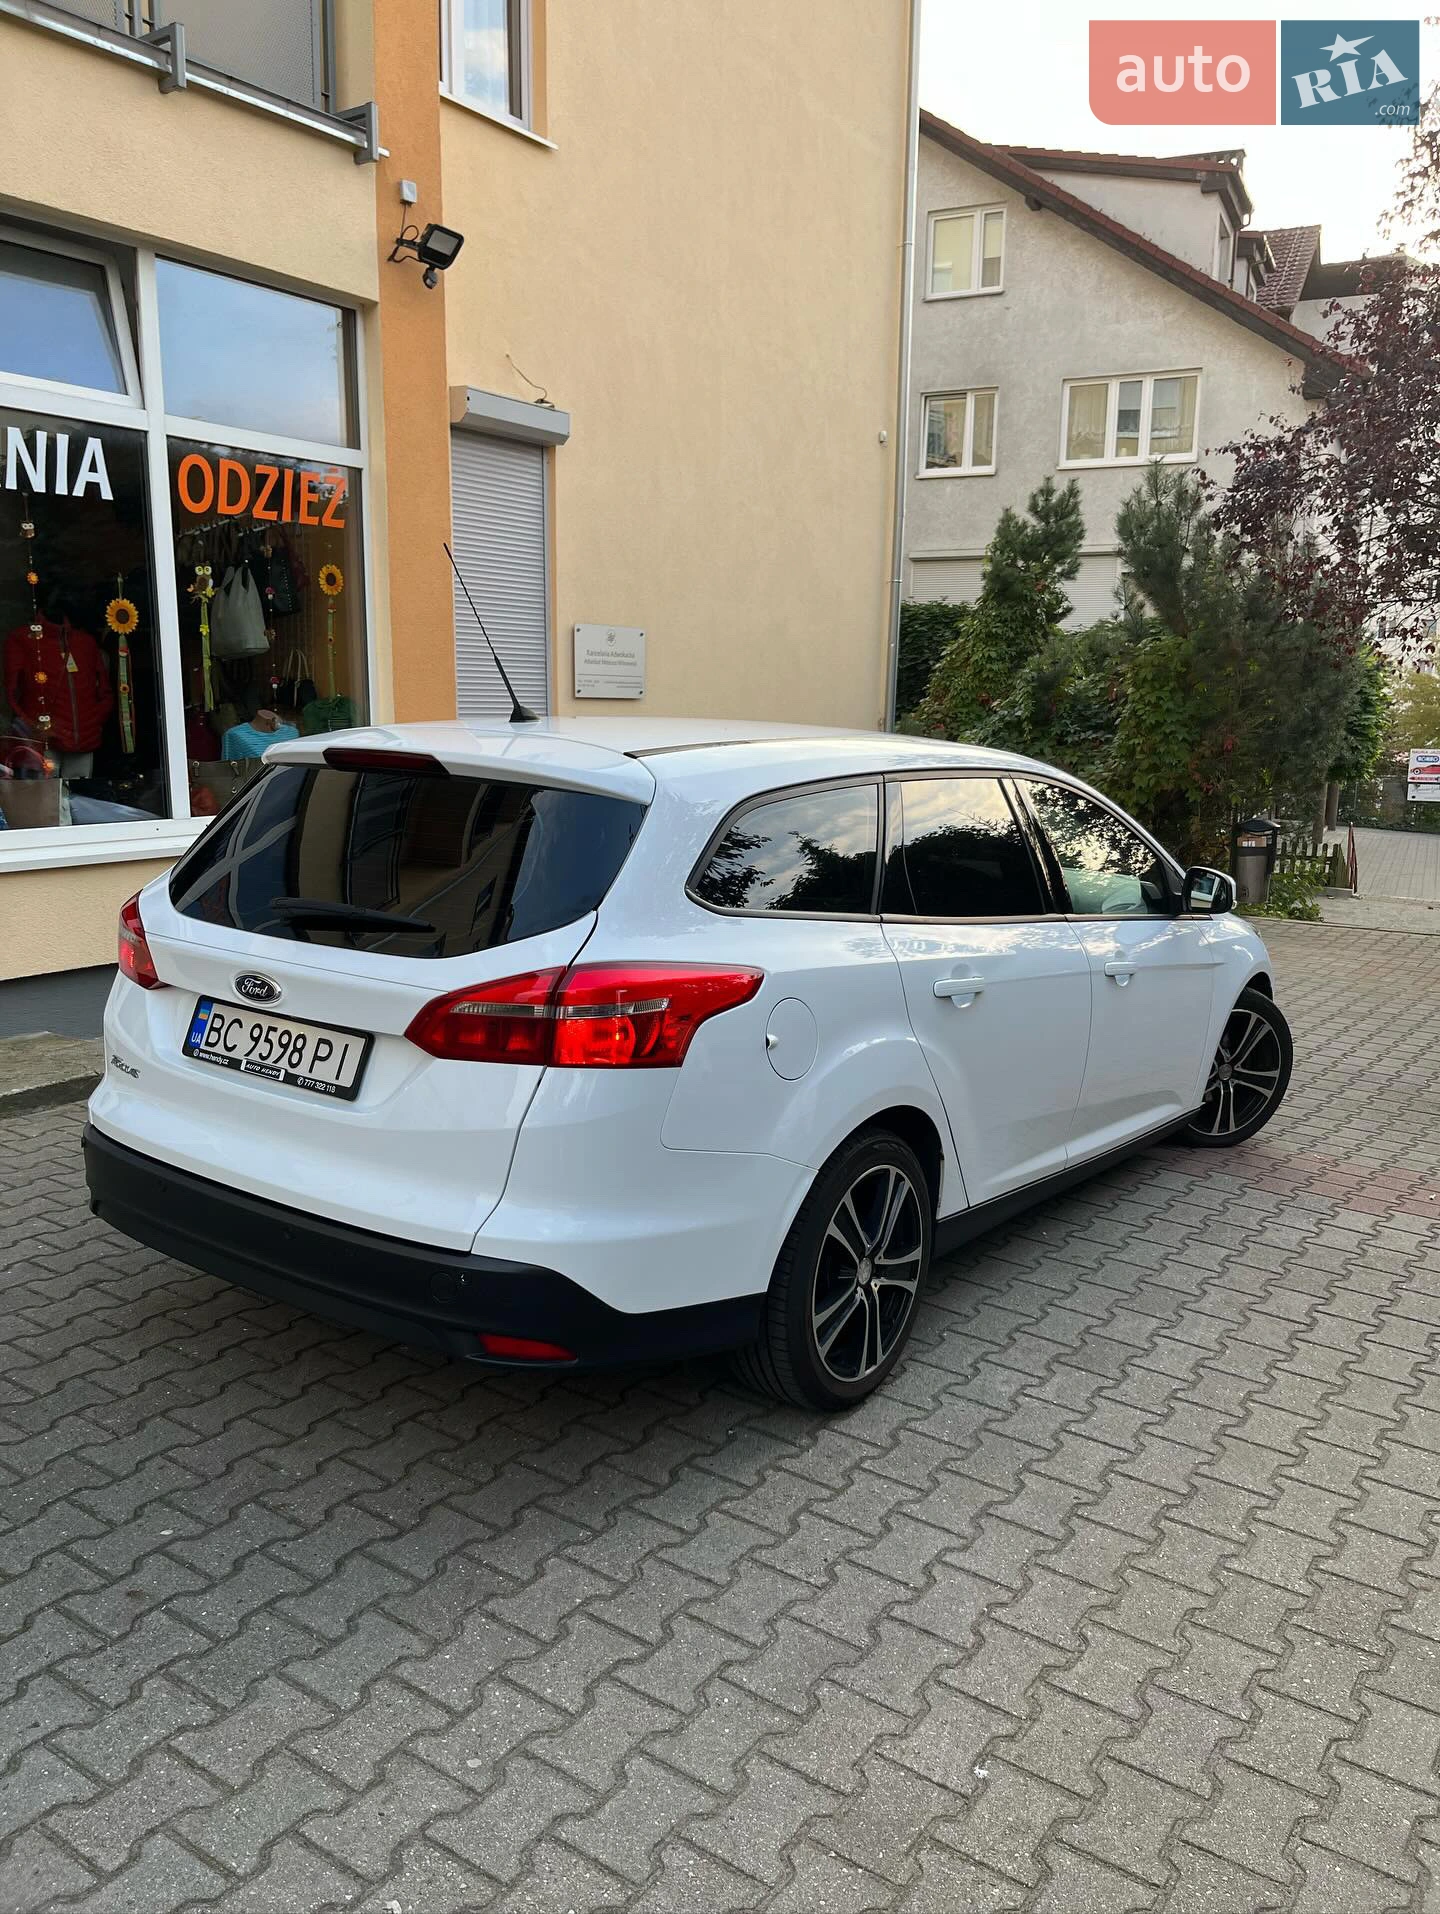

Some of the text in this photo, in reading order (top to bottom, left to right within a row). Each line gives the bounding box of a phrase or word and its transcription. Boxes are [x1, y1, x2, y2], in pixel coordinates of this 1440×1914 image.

[0, 426, 114, 500] NIA
[177, 453, 347, 529] ODZIEŻ
[241, 977, 269, 998] Ford
[191, 1031, 202, 1045] UA
[204, 1012, 350, 1081] BC 9598 PI
[245, 1063, 261, 1072] AUTO
[304, 1079, 315, 1088] 777
